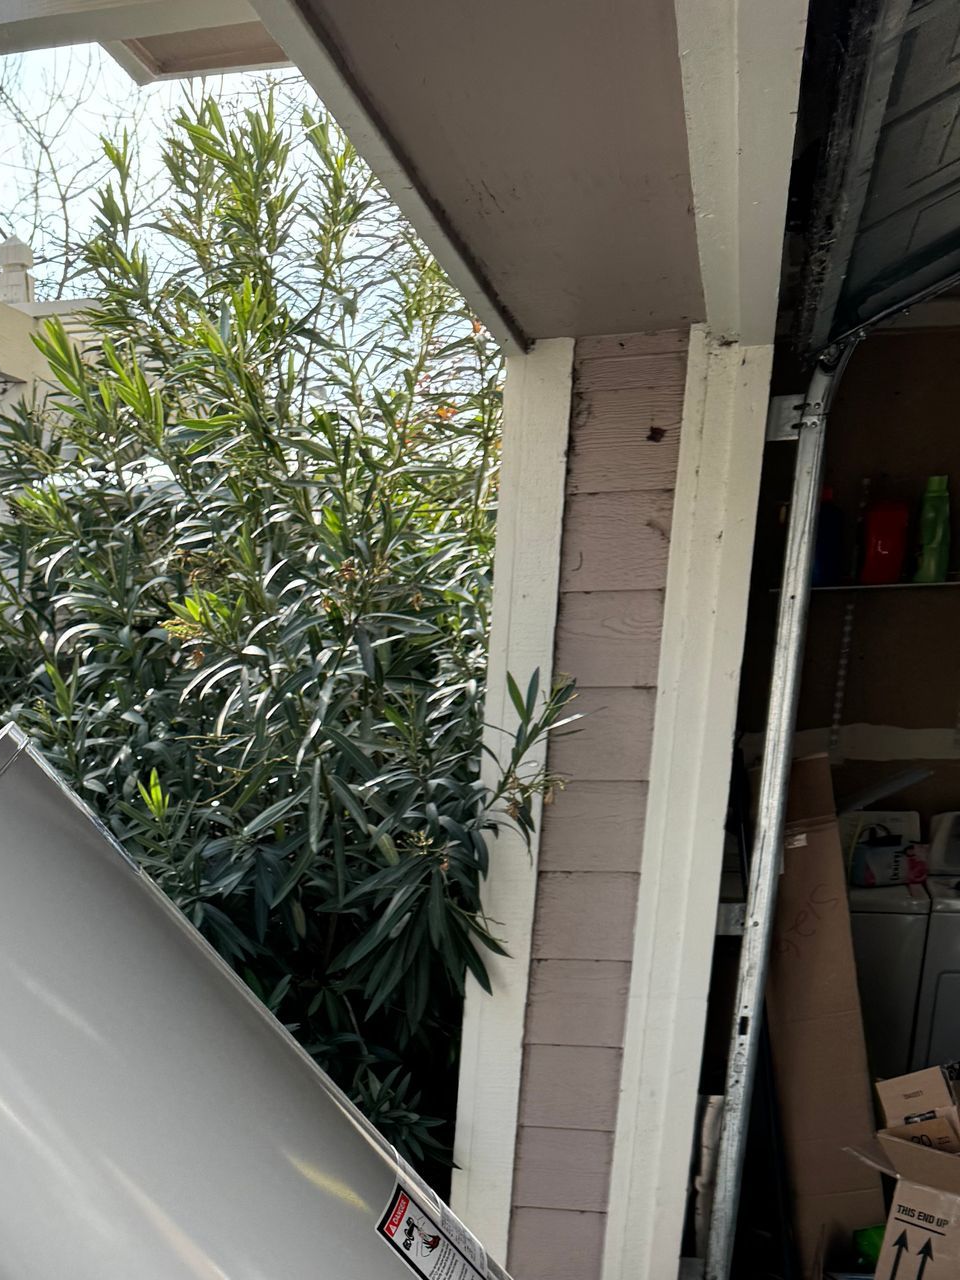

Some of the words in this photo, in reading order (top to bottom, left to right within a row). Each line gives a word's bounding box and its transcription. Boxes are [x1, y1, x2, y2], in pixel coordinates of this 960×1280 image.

[897, 1203, 916, 1218] THIS
[917, 1211, 935, 1224] END
[936, 1218, 949, 1229] UP
